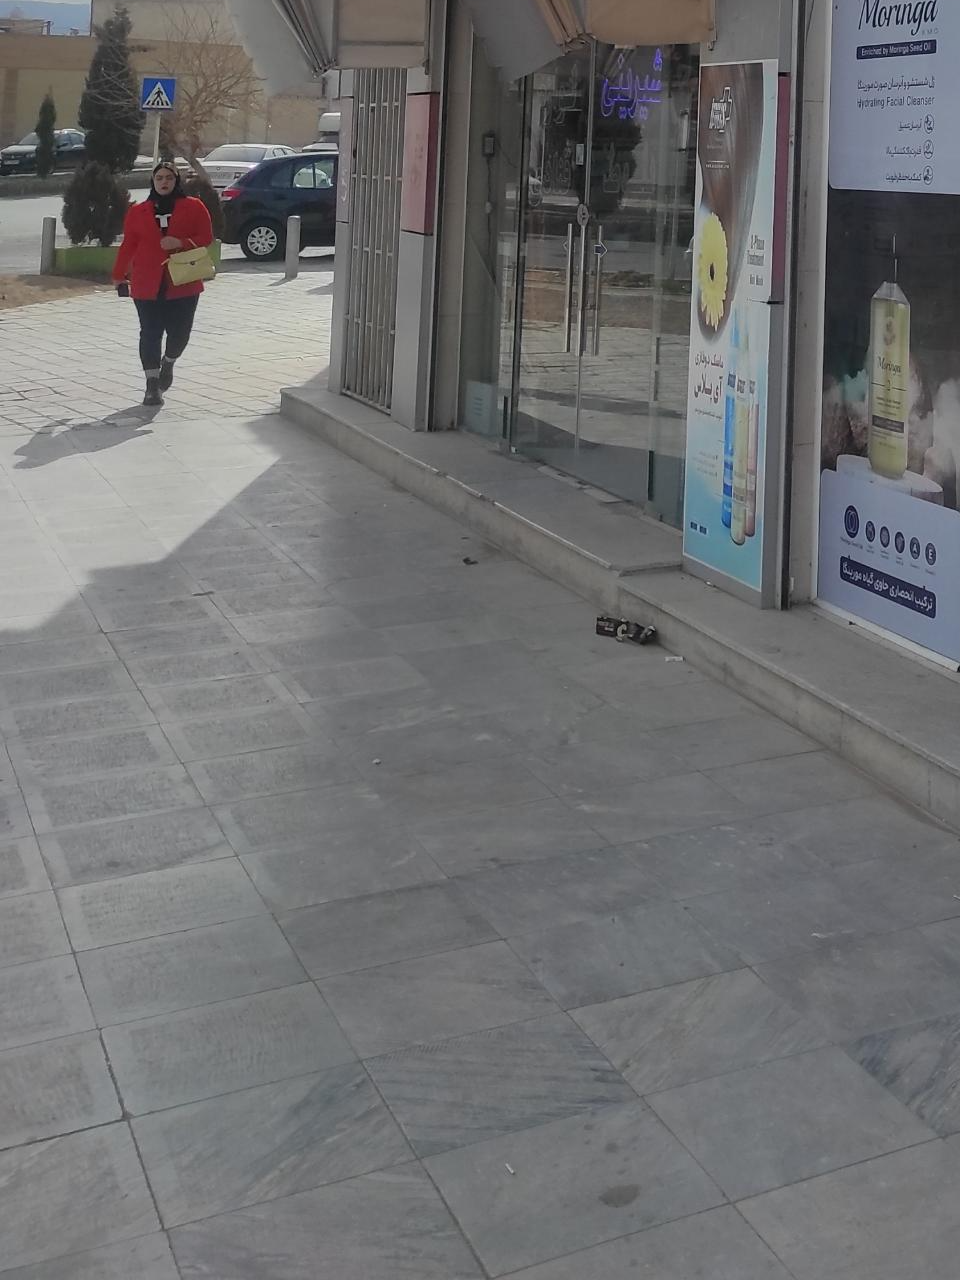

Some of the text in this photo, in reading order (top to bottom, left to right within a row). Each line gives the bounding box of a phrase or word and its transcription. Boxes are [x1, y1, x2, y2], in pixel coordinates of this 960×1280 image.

[857, 94, 935, 111] Hydrating Facial Cleanser
[873, 579, 889, 592] حاوی
[889, 582, 914, 602] انحصاری
[914, 594, 933, 610] ترکیب
